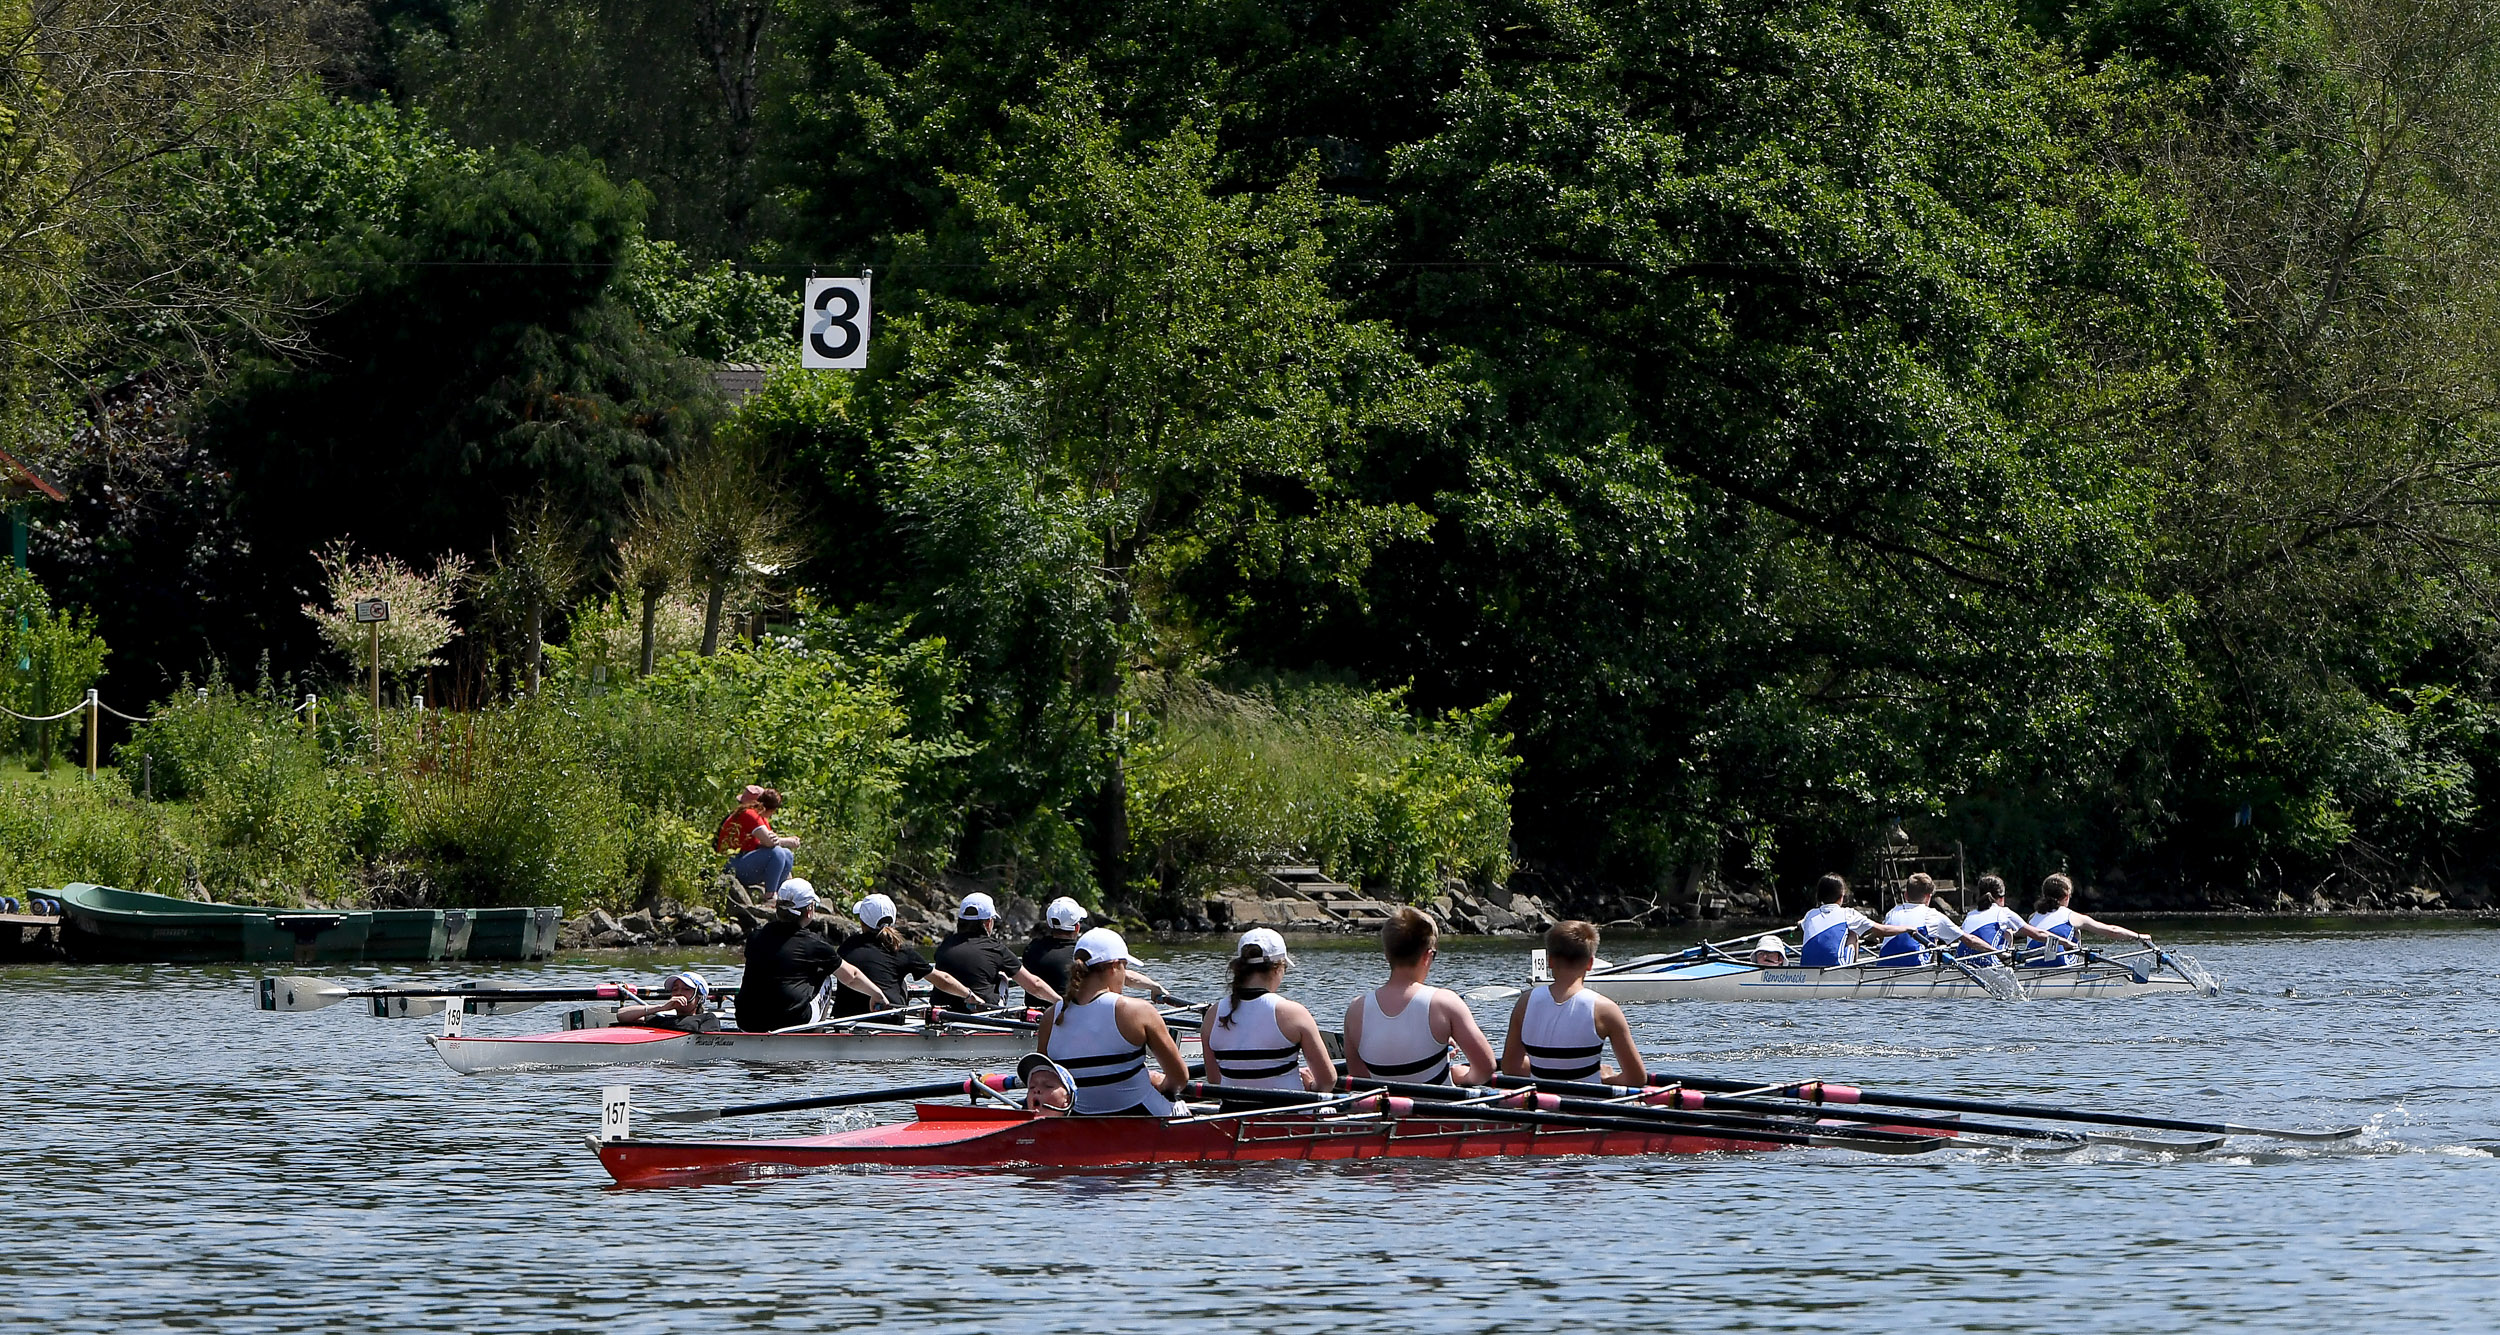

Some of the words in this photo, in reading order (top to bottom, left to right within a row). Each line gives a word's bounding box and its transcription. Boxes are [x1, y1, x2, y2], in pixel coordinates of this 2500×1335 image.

[809, 286, 862, 359] 3
[1534, 958, 1545, 971] 158
[1763, 970, 1806, 983] Rennschnecke
[447, 1009, 461, 1026] 159
[605, 1102, 626, 1125] 157
